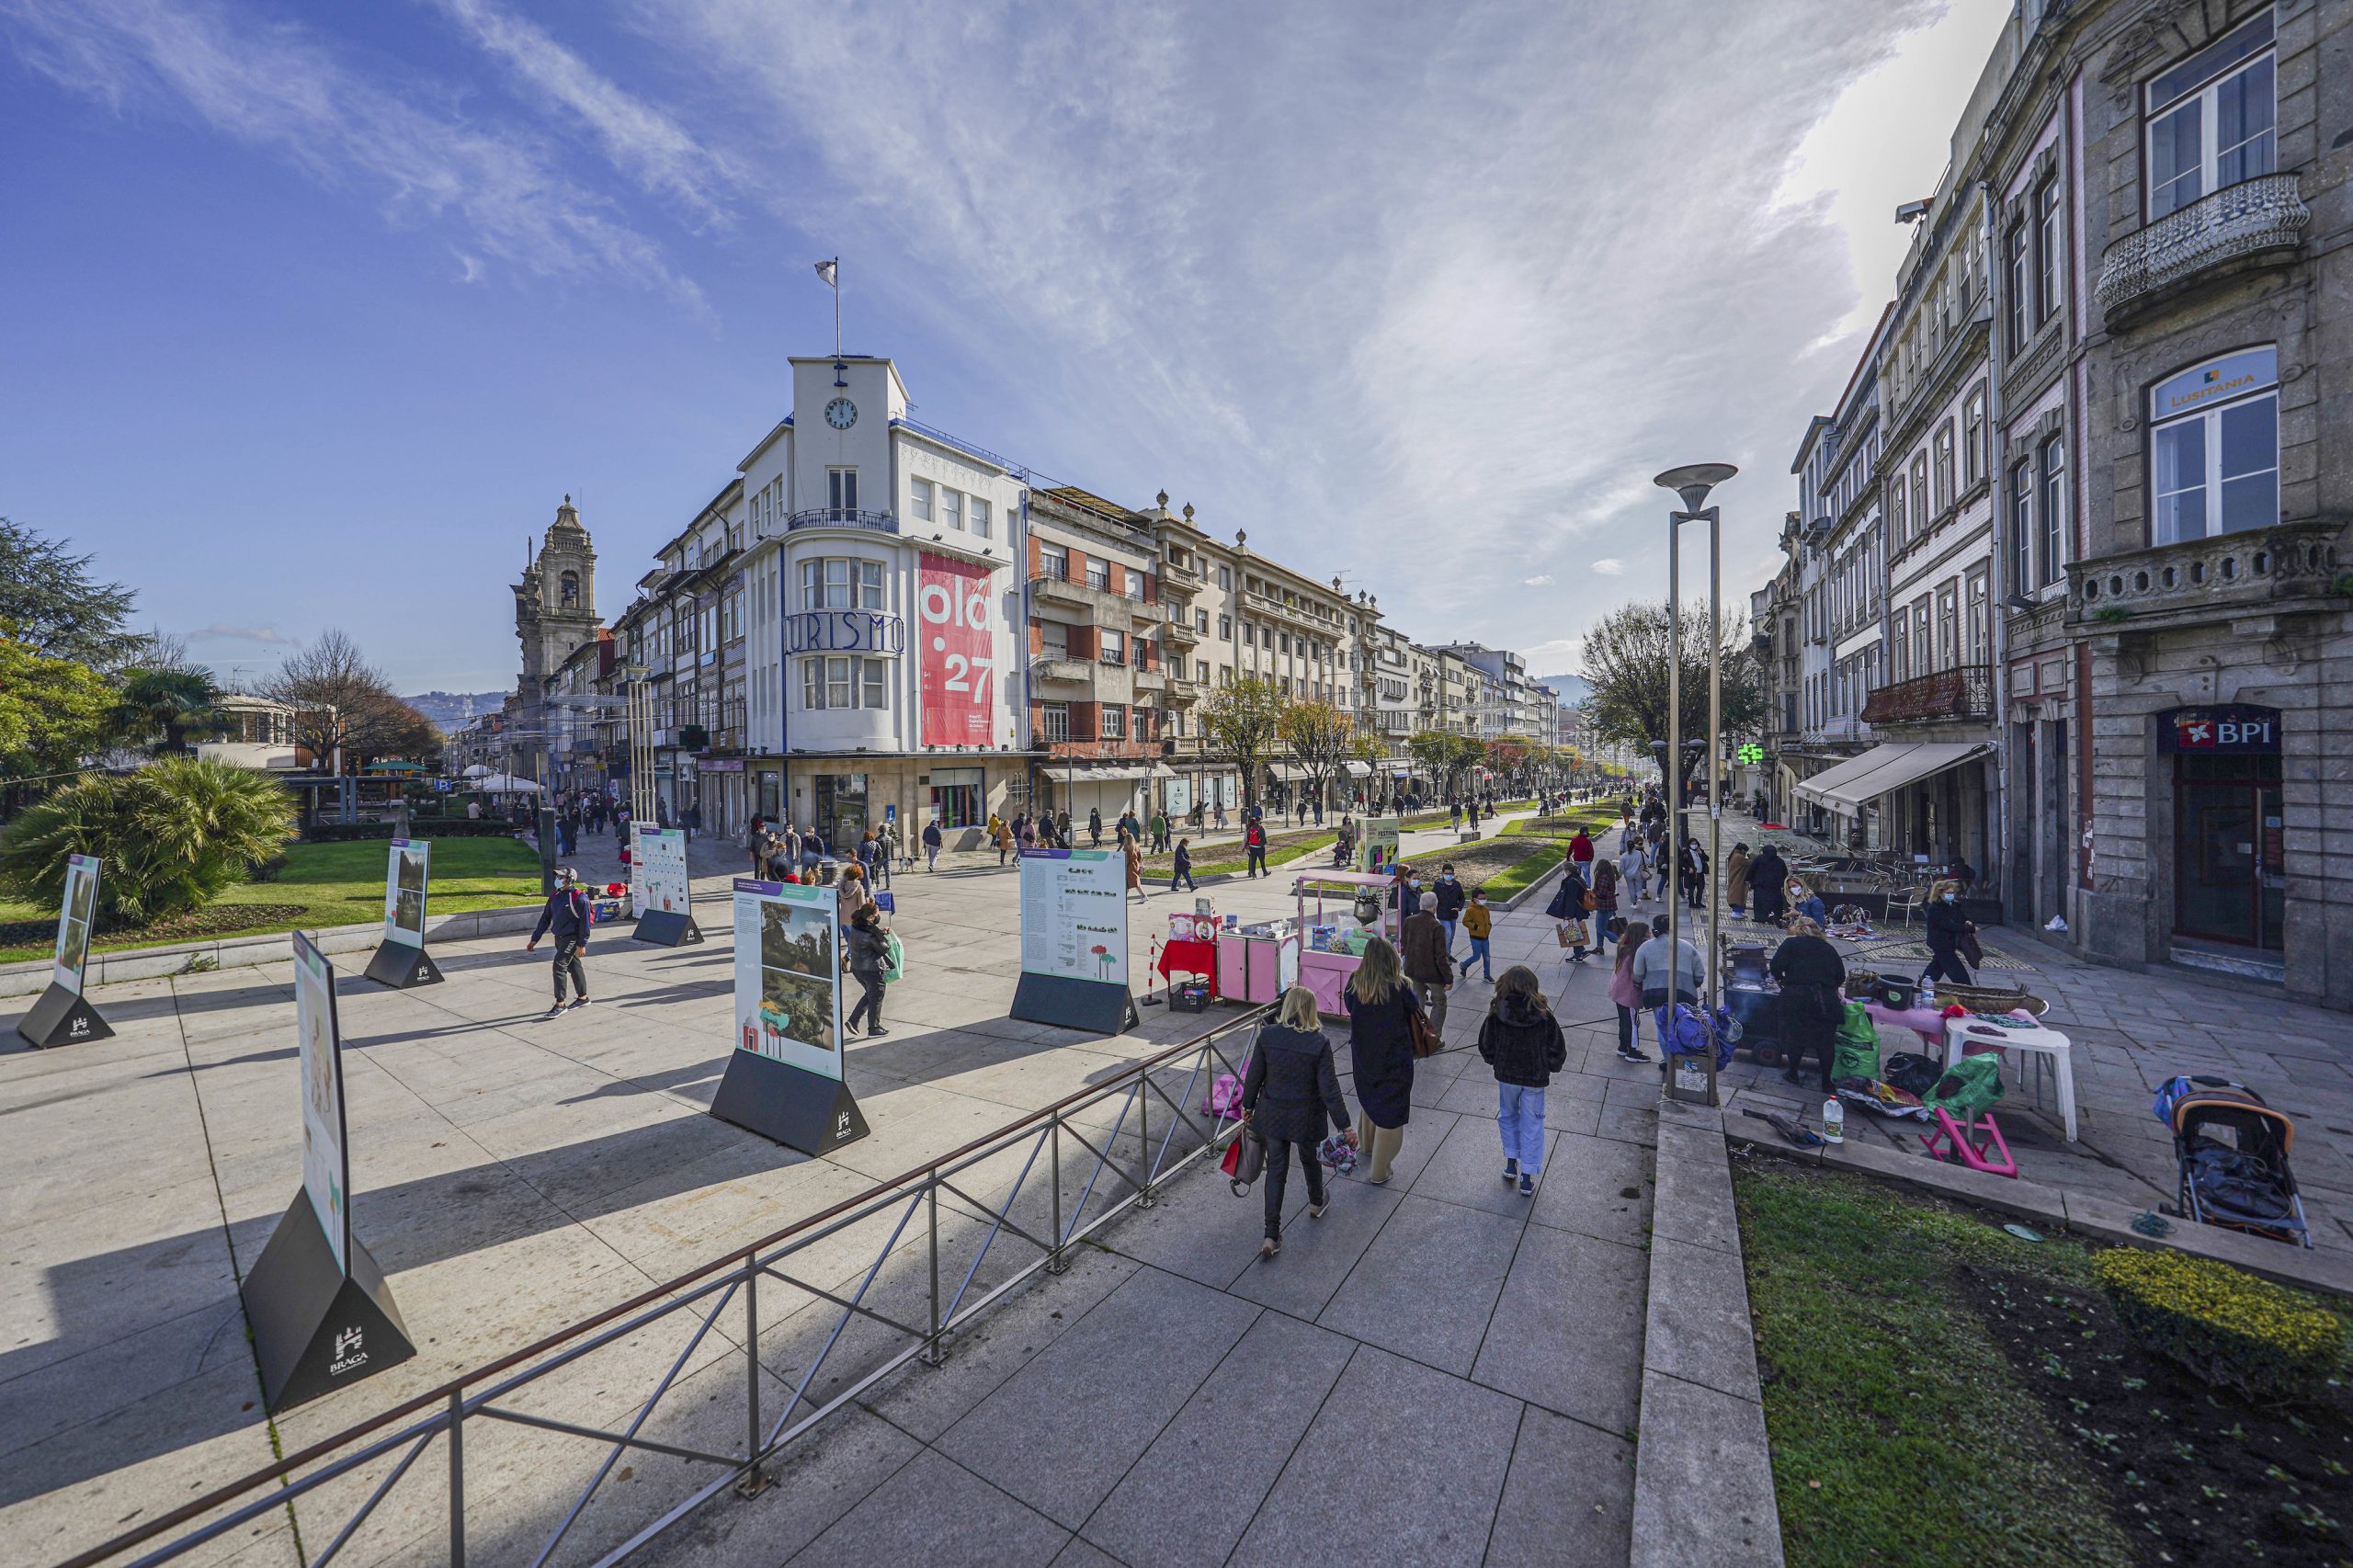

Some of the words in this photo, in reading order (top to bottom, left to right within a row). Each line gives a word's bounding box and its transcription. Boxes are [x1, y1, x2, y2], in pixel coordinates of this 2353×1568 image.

[2171, 374, 2255, 407] LUSITANIA
[920, 574, 993, 631] olá
[784, 611, 904, 653] URISMO
[2218, 722, 2270, 744] BPI
[330, 1352, 369, 1372] BRAGA
